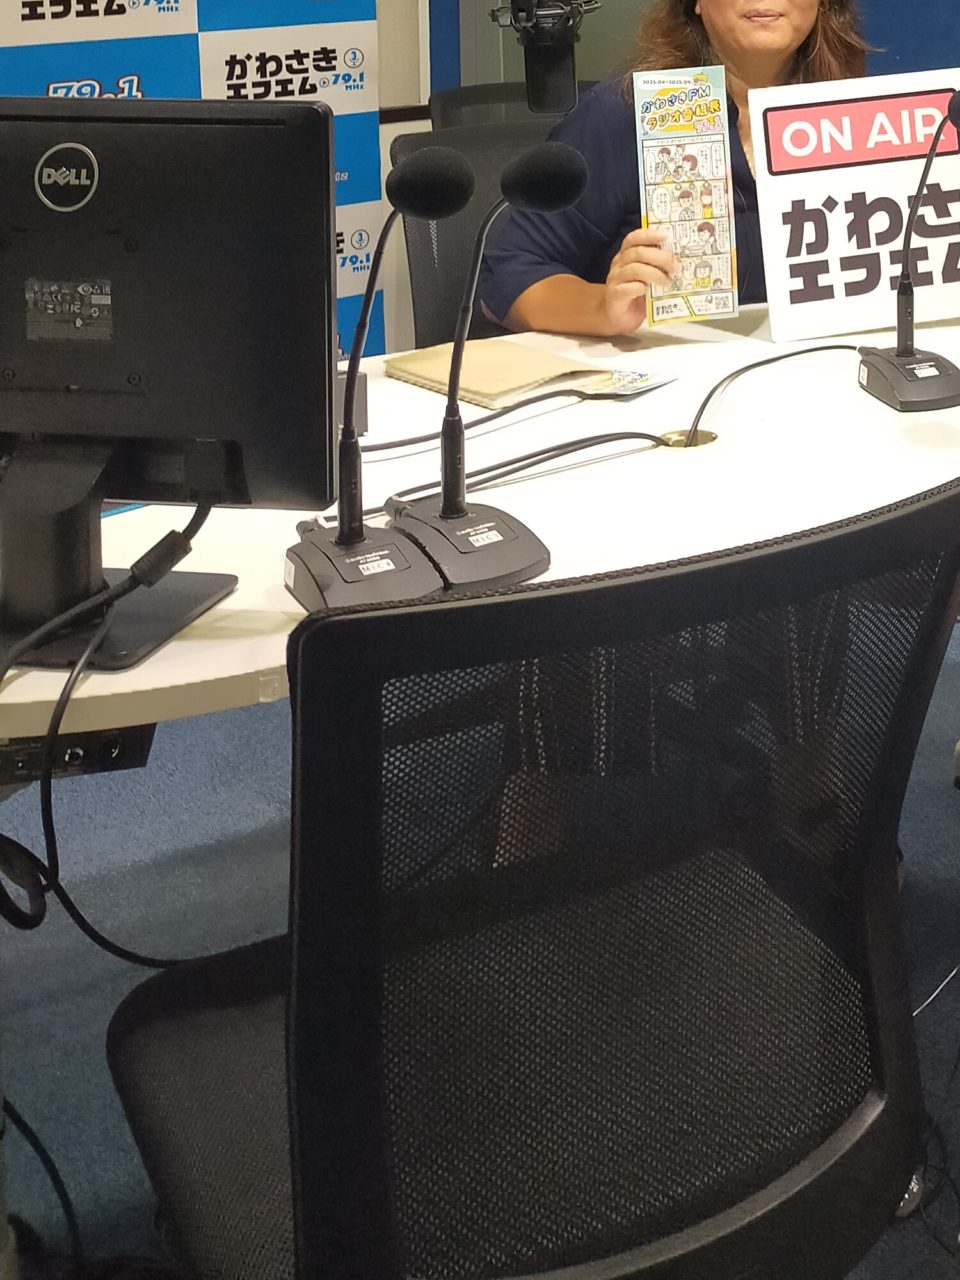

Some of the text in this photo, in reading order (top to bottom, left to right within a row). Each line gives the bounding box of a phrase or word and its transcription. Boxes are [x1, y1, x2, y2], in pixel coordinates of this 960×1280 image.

[158, 4, 179, 13] MHz
[225, 47, 337, 82] かわさき
[226, 72, 364, 100] エフエム 79.1
[641, 85, 711, 114] かわさきFM
[782, 107, 948, 157] ON AIR
[42, 166, 91, 187] DELL
[340, 253, 370, 268] 79.1
